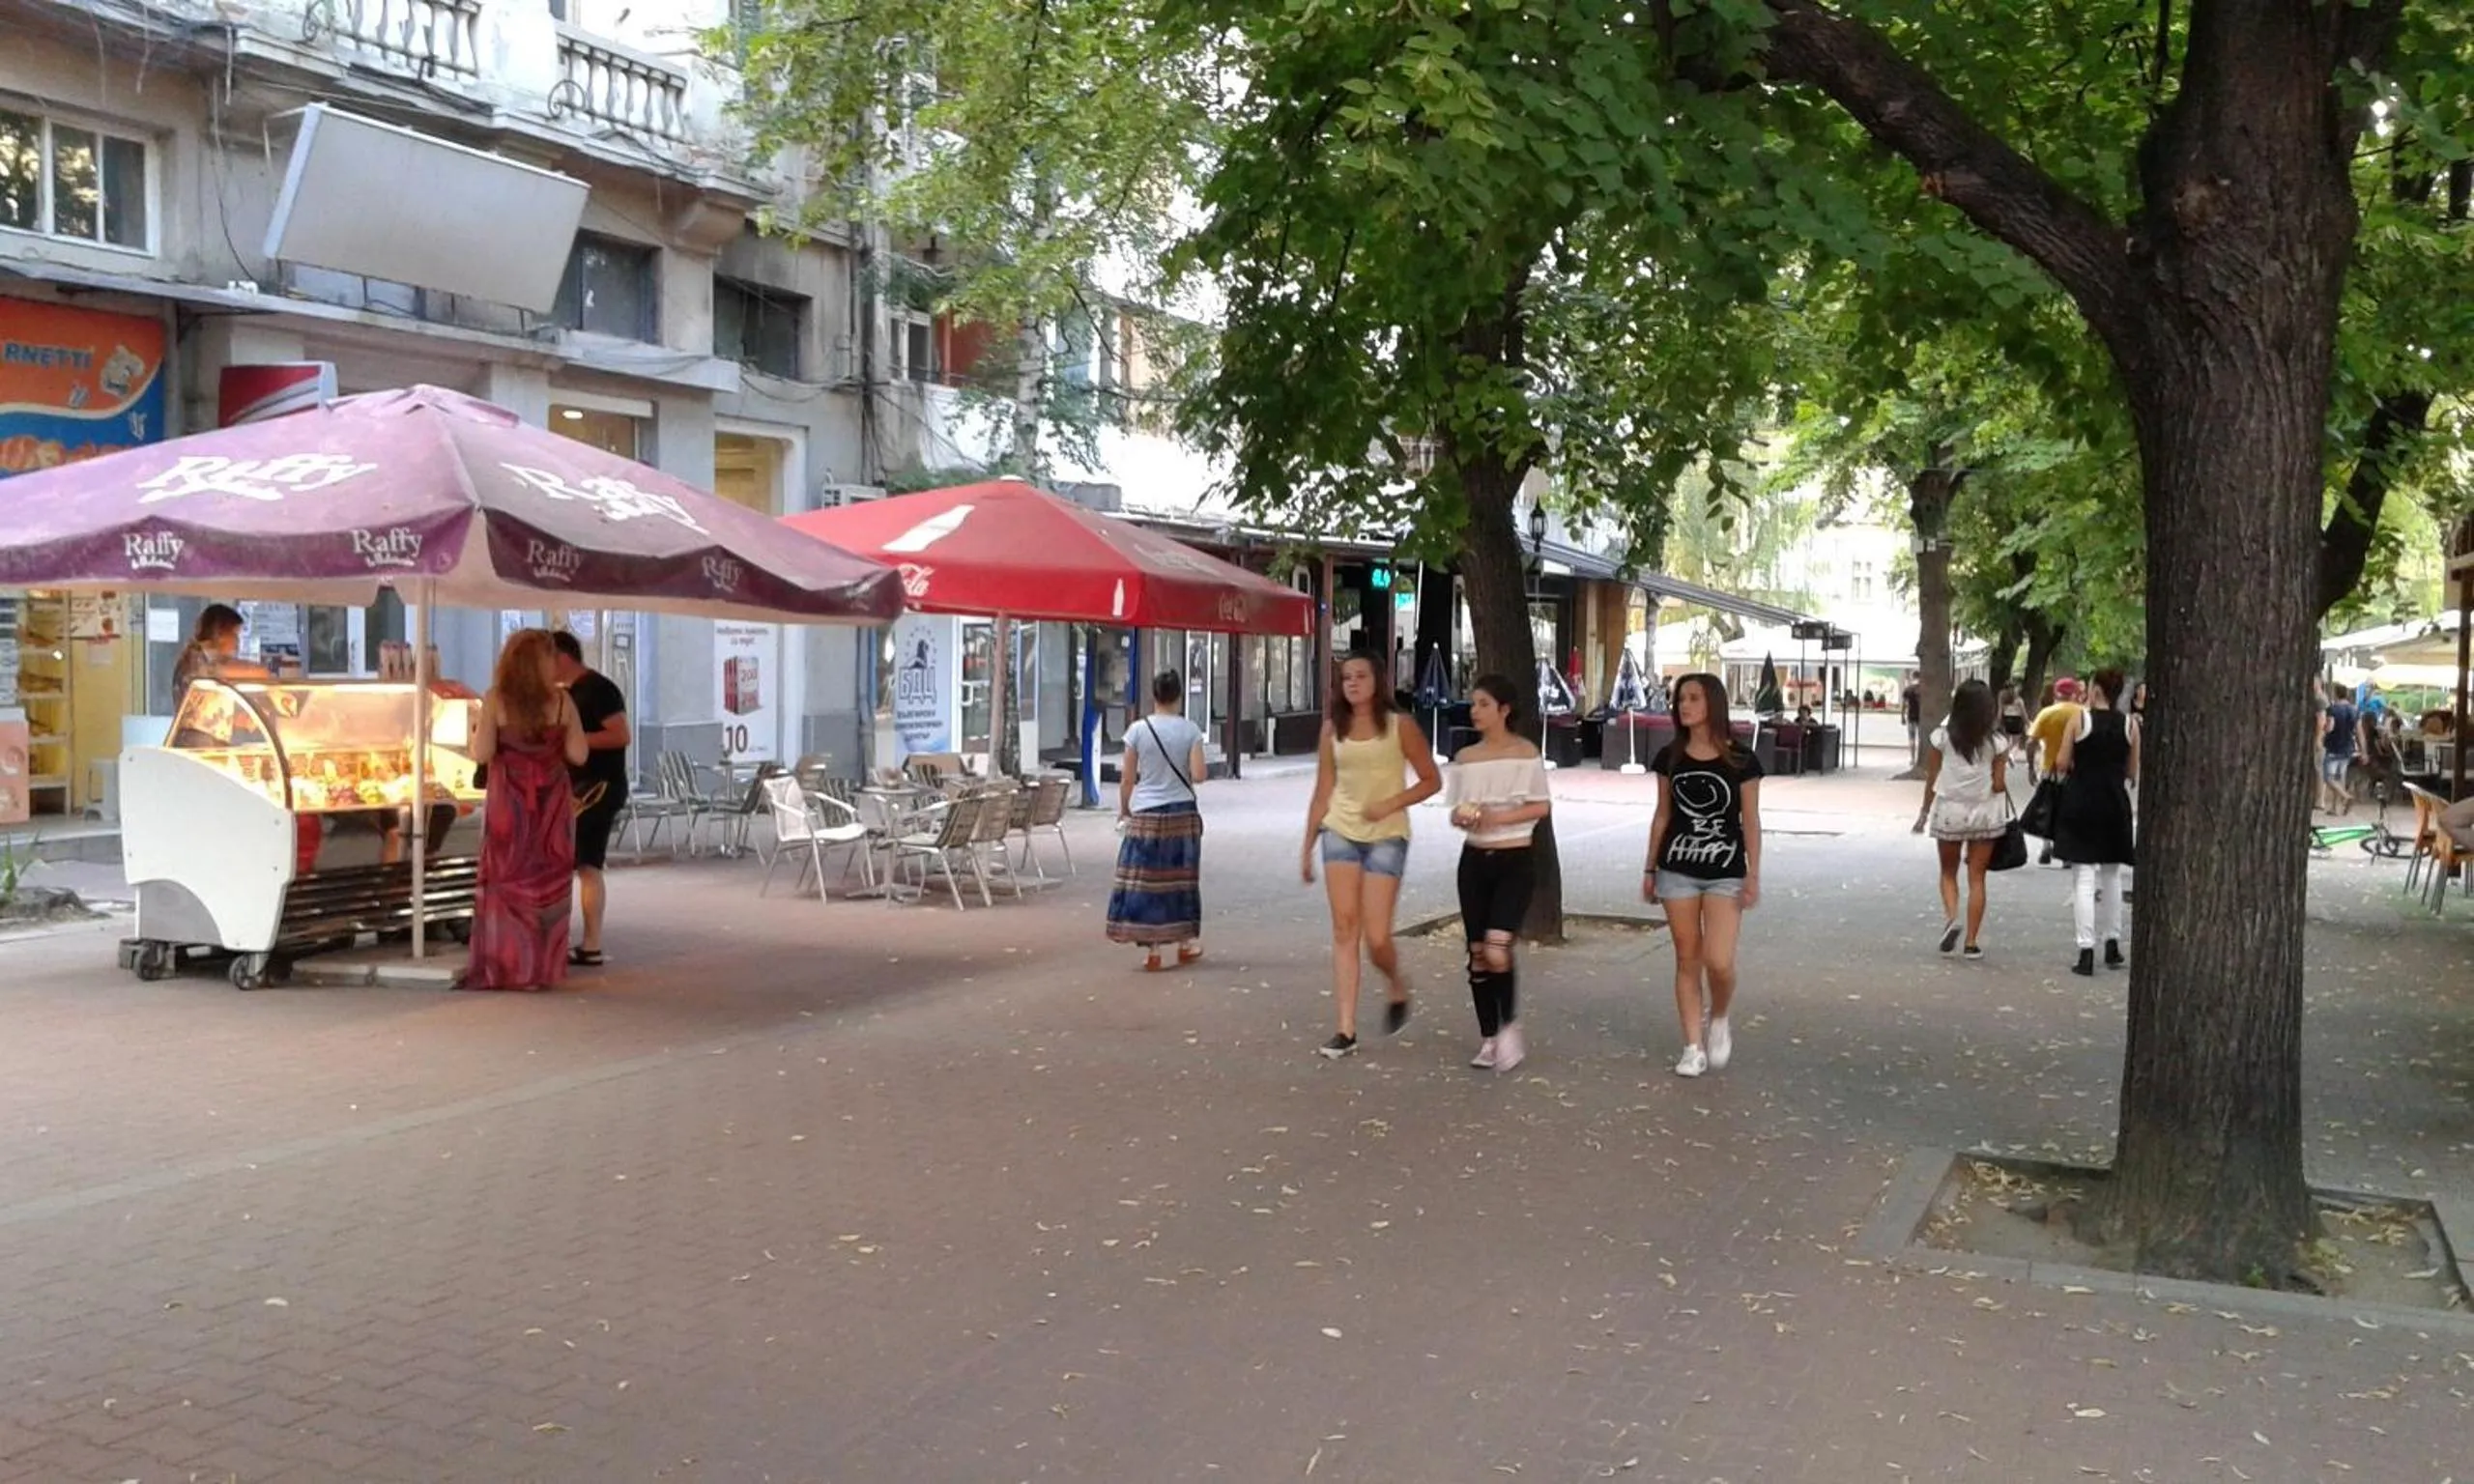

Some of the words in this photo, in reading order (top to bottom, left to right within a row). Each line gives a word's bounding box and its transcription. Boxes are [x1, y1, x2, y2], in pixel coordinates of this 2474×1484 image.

[123, 530, 185, 561] Raffy
[351, 527, 422, 557] Raffy
[526, 539, 583, 576] Raffy
[702, 556, 742, 586] Rffy
[1691, 818, 1727, 840] BE
